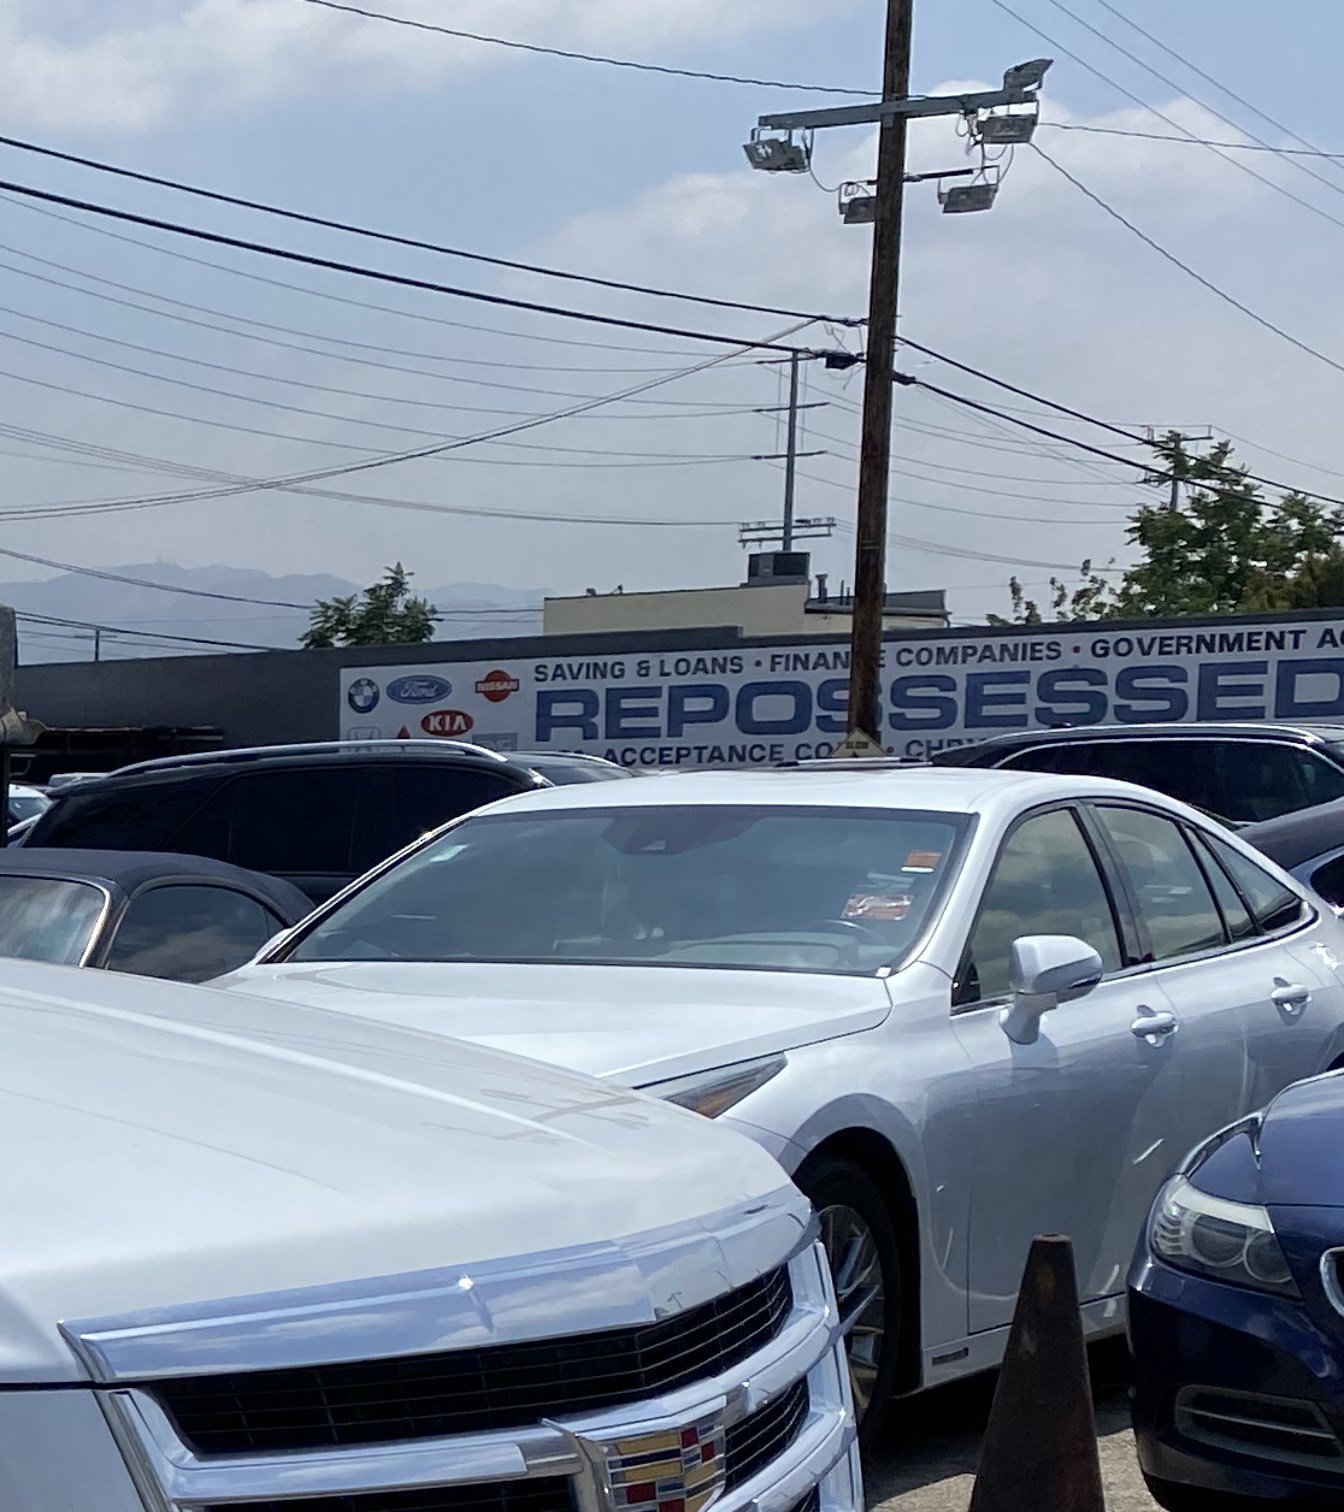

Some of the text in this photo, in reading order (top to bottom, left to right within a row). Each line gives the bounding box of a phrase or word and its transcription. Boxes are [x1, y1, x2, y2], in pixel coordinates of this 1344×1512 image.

[534, 627, 1344, 683] SAVING & LOANS FINANE COMPANIES GOVERNMENT A
[429, 715, 467, 731] KIA
[603, 744, 785, 767] ACCEPTANCE
